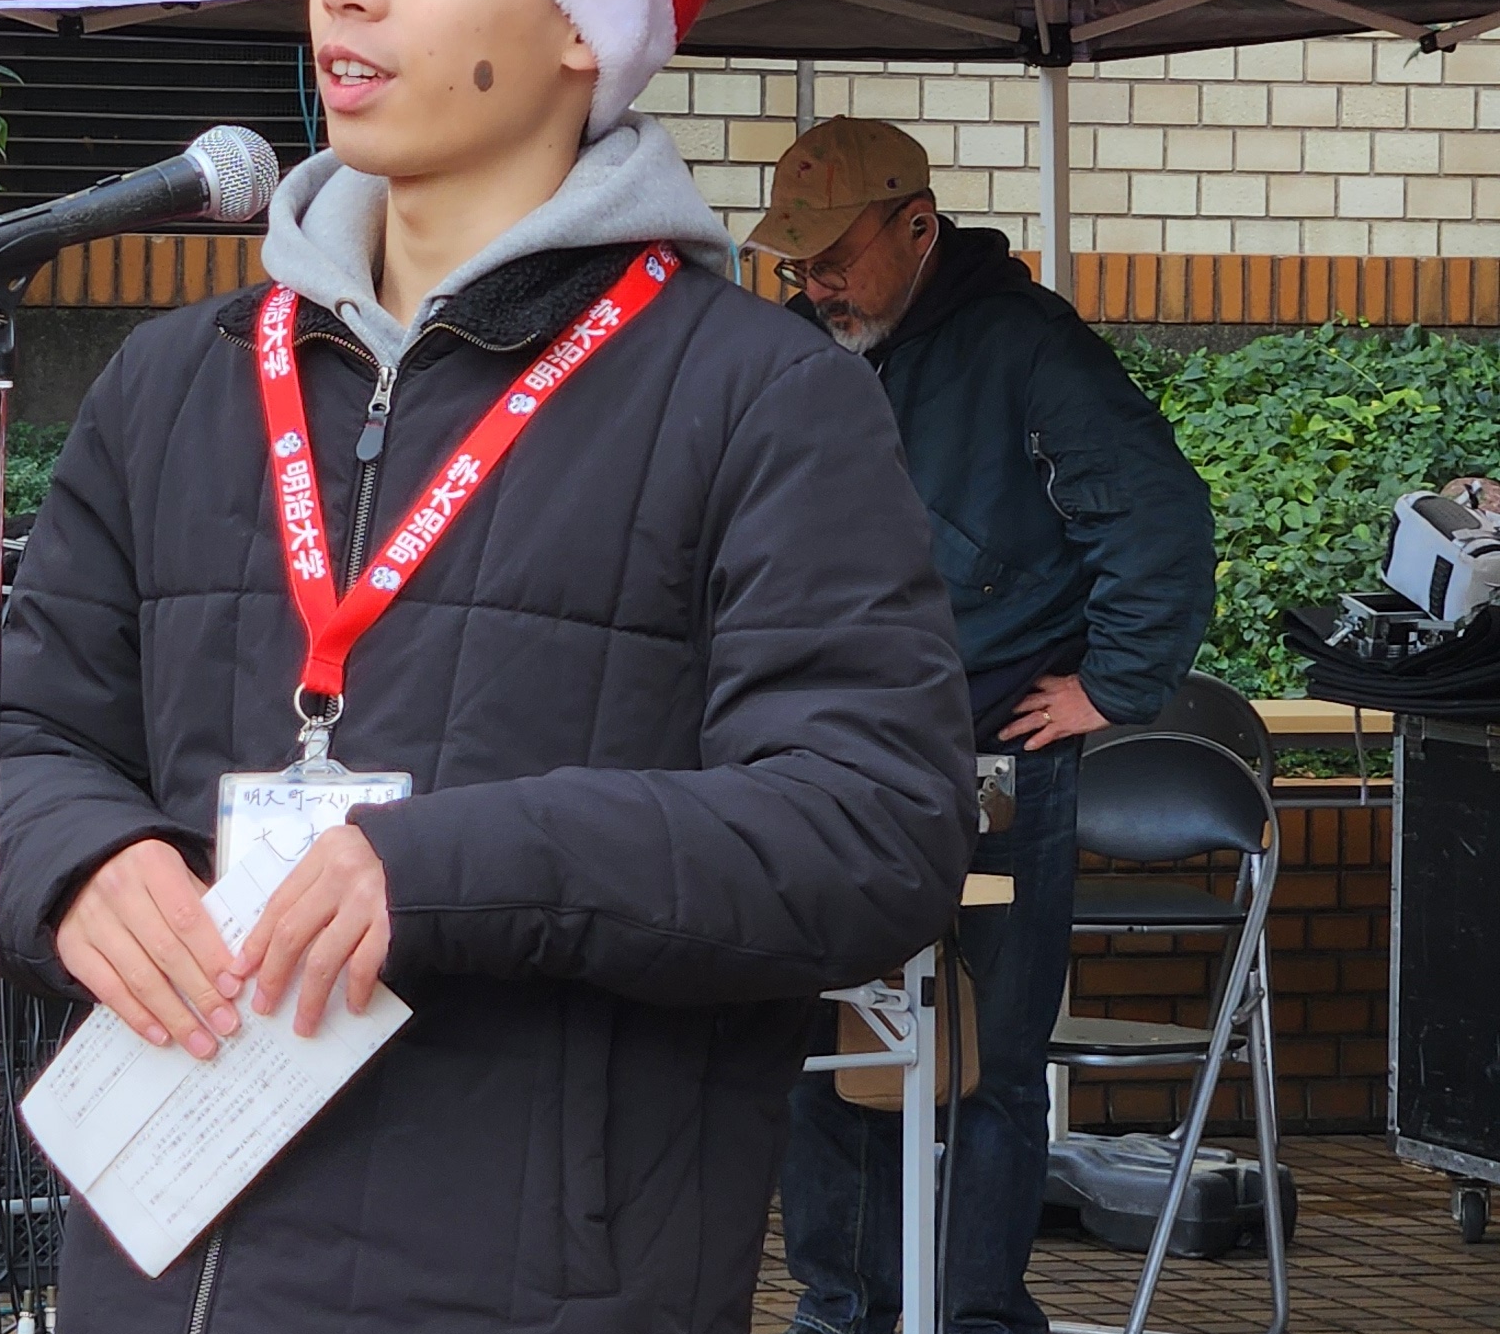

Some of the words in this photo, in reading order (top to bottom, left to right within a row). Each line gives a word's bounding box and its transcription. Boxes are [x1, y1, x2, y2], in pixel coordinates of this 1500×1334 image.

[262, 289, 296, 380] 明治大学
[524, 299, 621, 392] 明治大学
[280, 458, 326, 581] 明治大学
[385, 453, 481, 565] 明治大学
